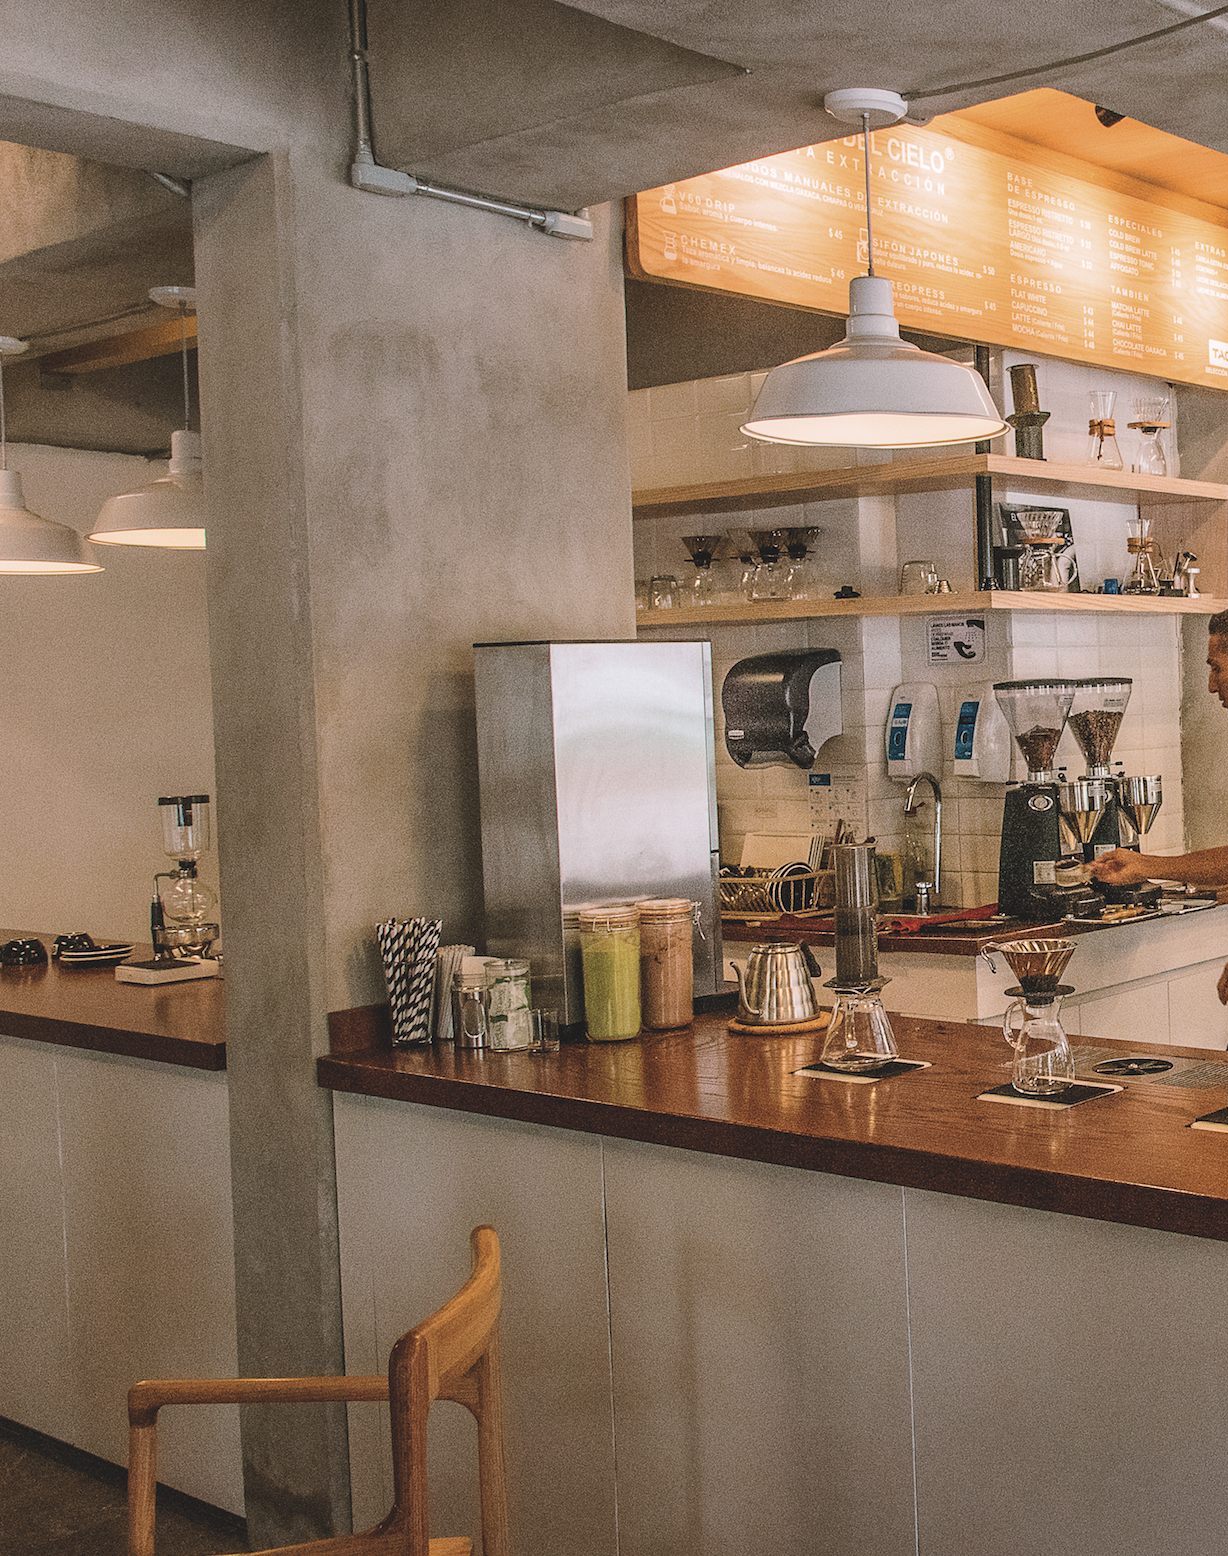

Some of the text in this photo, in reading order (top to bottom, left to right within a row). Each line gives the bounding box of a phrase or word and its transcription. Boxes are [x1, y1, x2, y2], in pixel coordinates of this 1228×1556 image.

[844, 132, 882, 156] DEL
[826, 150, 944, 195] EXTRACCIÓN
[1007, 172, 1032, 188] BASE
[754, 176, 768, 187] CON
[770, 180, 794, 194] MEZCLA
[795, 187, 822, 202] OAXACA,
[784, 172, 948, 223] MANUALES EXTRACCIÓN
[1008, 183, 1075, 211] DE ESPRESSO
[678, 191, 735, 212] V60 DRIP
[702, 208, 723, 220] aroma
[730, 214, 752, 227] cuerpo
[754, 219, 778, 232] intenso.
[1008, 198, 1074, 225] ESPRESSO RISTRETTO
[1008, 219, 1041, 236] ESPRESSO
[1042, 228, 1074, 244] RISTRETTO
[1008, 228, 1030, 240] LARGO
[1108, 214, 1162, 238] ESPECIALES
[680, 234, 736, 255] CHEMEX
[1108, 228, 1141, 244] COLD BREW
[872, 238, 958, 266] SIFÓN JAPONÉS
[1010, 240, 1046, 256] AMERICANO
[1109, 240, 1158, 260] COLD BREW LATTE
[1195, 241, 1226, 257] EXTRAS
[682, 255, 720, 270] la amargura
[682, 246, 696, 256] Taza
[736, 256, 756, 269] limpia,
[758, 261, 785, 274] balancea
[786, 266, 792, 276] la
[792, 269, 812, 280] acidez
[812, 272, 832, 284] reduce
[1110, 250, 1138, 266] ESPRESSO
[1110, 262, 1139, 276] AFFOGATO
[1010, 274, 1062, 294] ESPRESSO
[1110, 284, 1148, 302] TAMBIÉN
[1011, 288, 1046, 304] FLAT WHITE
[1012, 300, 1048, 316] CAPUCCINO
[1111, 301, 1150, 318] MATCHA LATTE
[1012, 312, 1030, 324] LATTE
[1112, 320, 1142, 333] CHAI LATTE
[1012, 324, 1035, 336] MOCHA
[1112, 338, 1144, 352] CHOCOLATE
